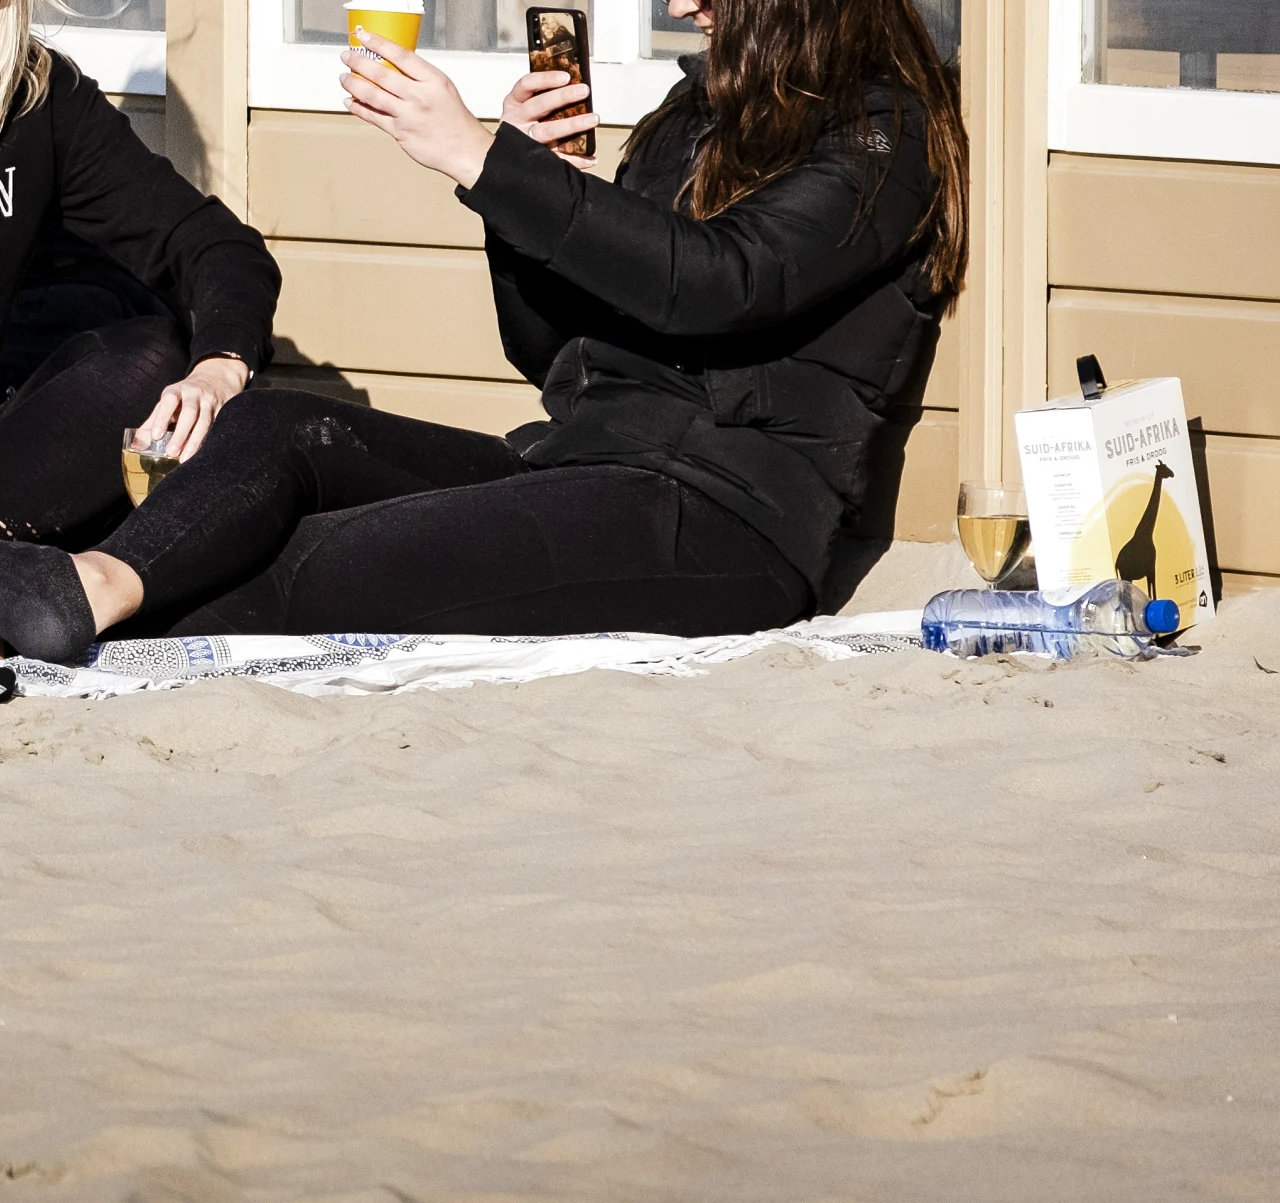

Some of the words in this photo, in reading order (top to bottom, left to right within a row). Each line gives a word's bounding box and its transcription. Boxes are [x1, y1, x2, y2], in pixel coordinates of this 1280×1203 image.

[1104, 417, 1181, 459] SUID-AFRIKA
[1024, 440, 1092, 455] SUID-AFRIKA
[1125, 456, 1140, 467] FRIS
[1146, 447, 1167, 460] DROOG
[1179, 568, 1195, 583] LITER
